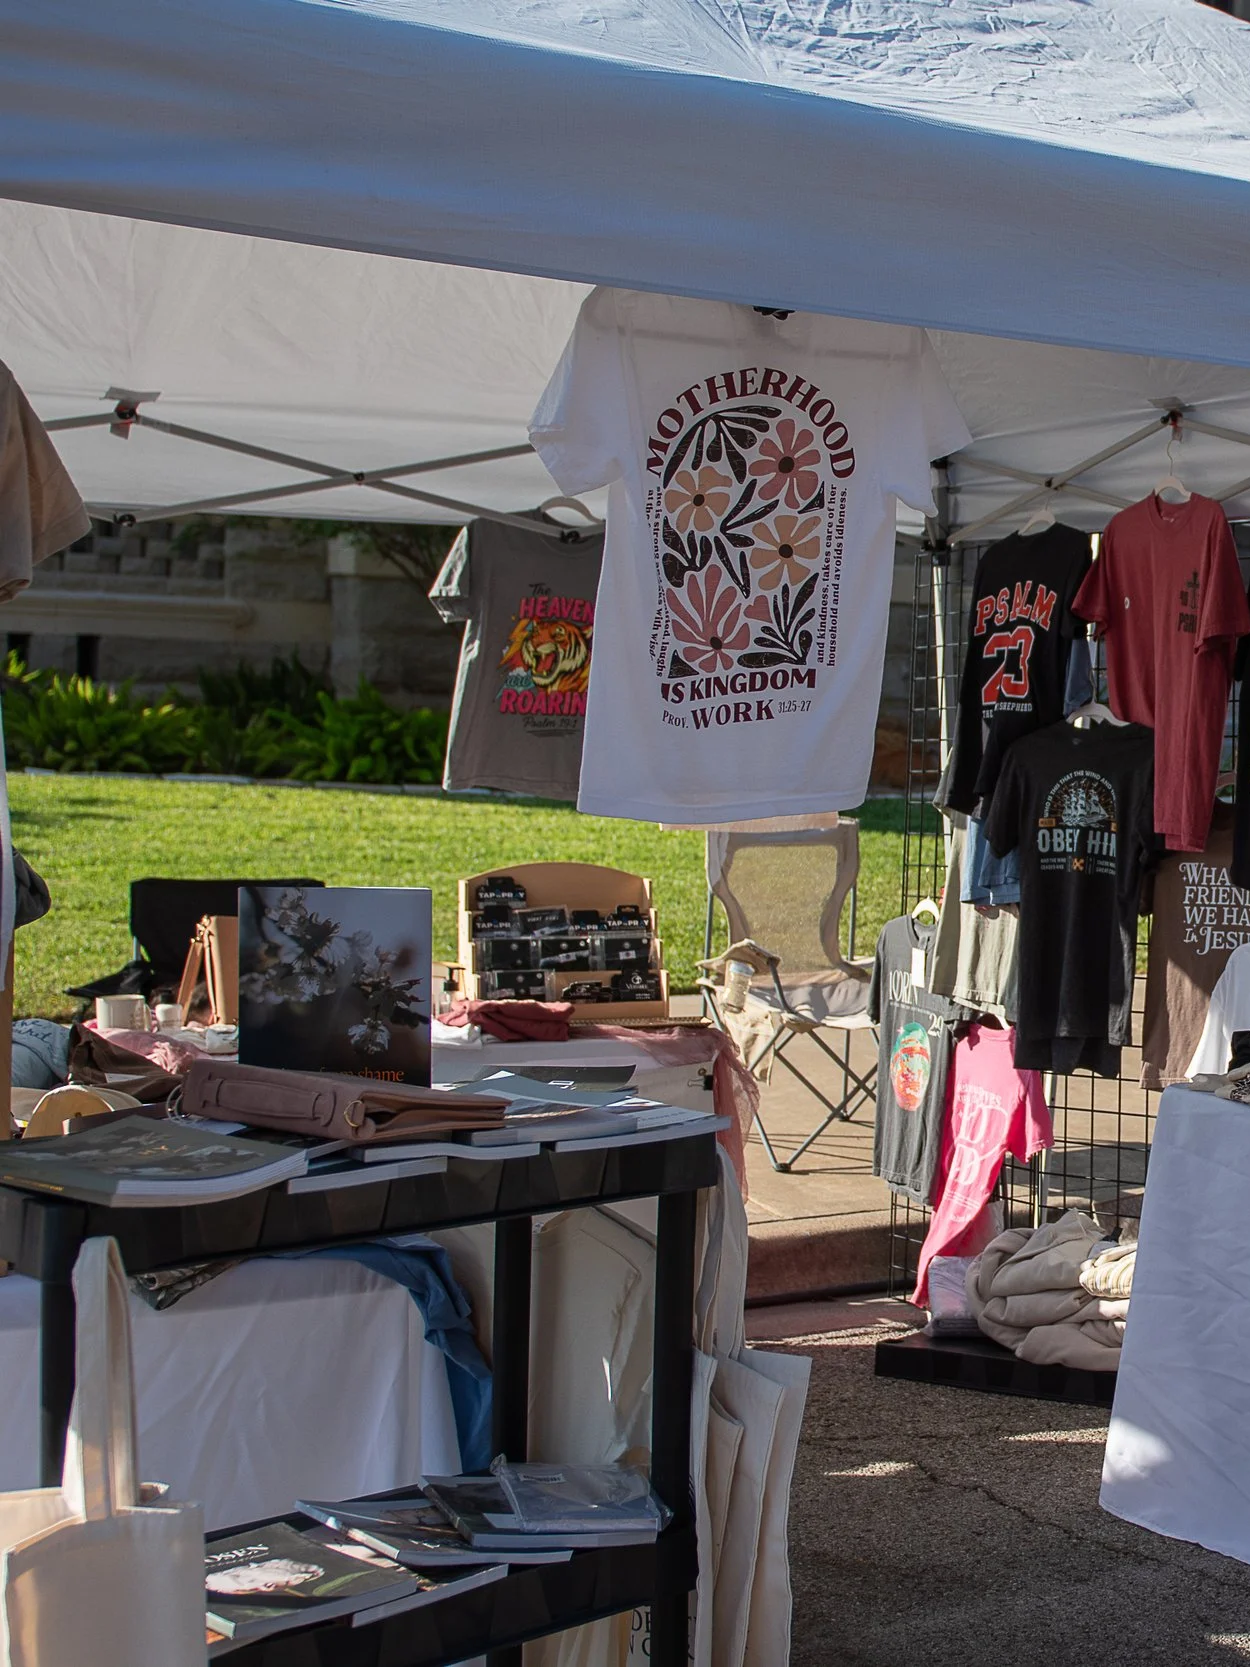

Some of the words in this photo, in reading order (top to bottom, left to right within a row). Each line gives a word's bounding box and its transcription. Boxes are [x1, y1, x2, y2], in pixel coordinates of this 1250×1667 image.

[646, 367, 856, 479] MOTHERHOOD
[828, 484, 837, 504] her
[655, 508, 663, 519] is
[827, 507, 835, 519] of
[835, 488, 847, 540] idleness.
[822, 550, 831, 581] takes
[834, 542, 843, 580] avoids
[528, 581, 552, 596] The
[832, 583, 840, 605] and
[519, 596, 596, 624] HEAVEN
[652, 608, 663, 631] with
[817, 584, 830, 639] kindness,
[974, 580, 1057, 636] PSALM
[827, 608, 838, 667] household
[656, 641, 669, 678] laughs
[816, 641, 825, 663] and
[982, 625, 1035, 706] 23
[690, 668, 816, 702] KINGDOM
[500, 687, 588, 717] ROARIN
[691, 699, 775, 730] WORK
[778, 700, 812, 714] 31:25-27
[662, 710, 689, 729] PROV.
[1037, 828, 1080, 853] OBEY
[1179, 862, 1231, 886] WHA
[1184, 906, 1217, 926] WE
[358, 1066, 405, 1082] shame
